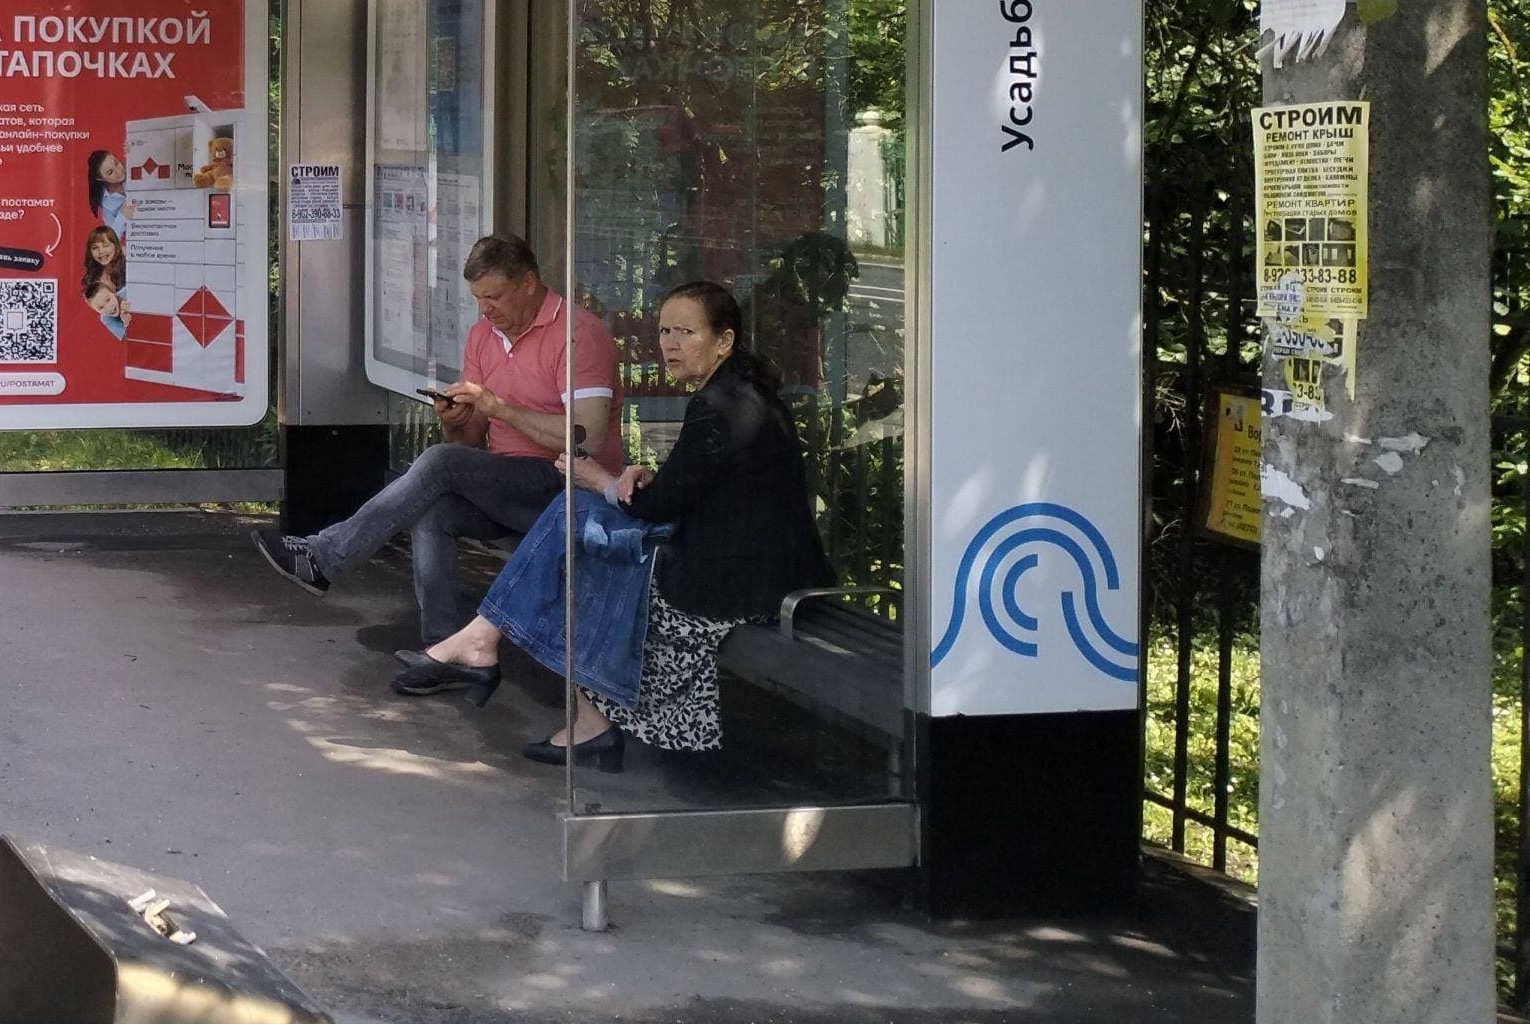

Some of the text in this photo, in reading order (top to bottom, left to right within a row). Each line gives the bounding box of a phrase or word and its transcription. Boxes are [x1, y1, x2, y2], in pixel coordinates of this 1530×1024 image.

[14, 10, 211, 45] ПОКУПКОЙ
[19, 103, 45, 112] сеть
[29, 117, 75, 128] которая
[1259, 105, 1363, 130] СТРОИМ
[1266, 128, 1354, 143] РЕМОНТ КРЫШ
[16, 143, 64, 154] удобнее
[291, 166, 339, 177] СТРОИМ
[1, 198, 55, 207] постамат
[1266, 198, 1356, 208] РЕМОНТ КВАРТИР
